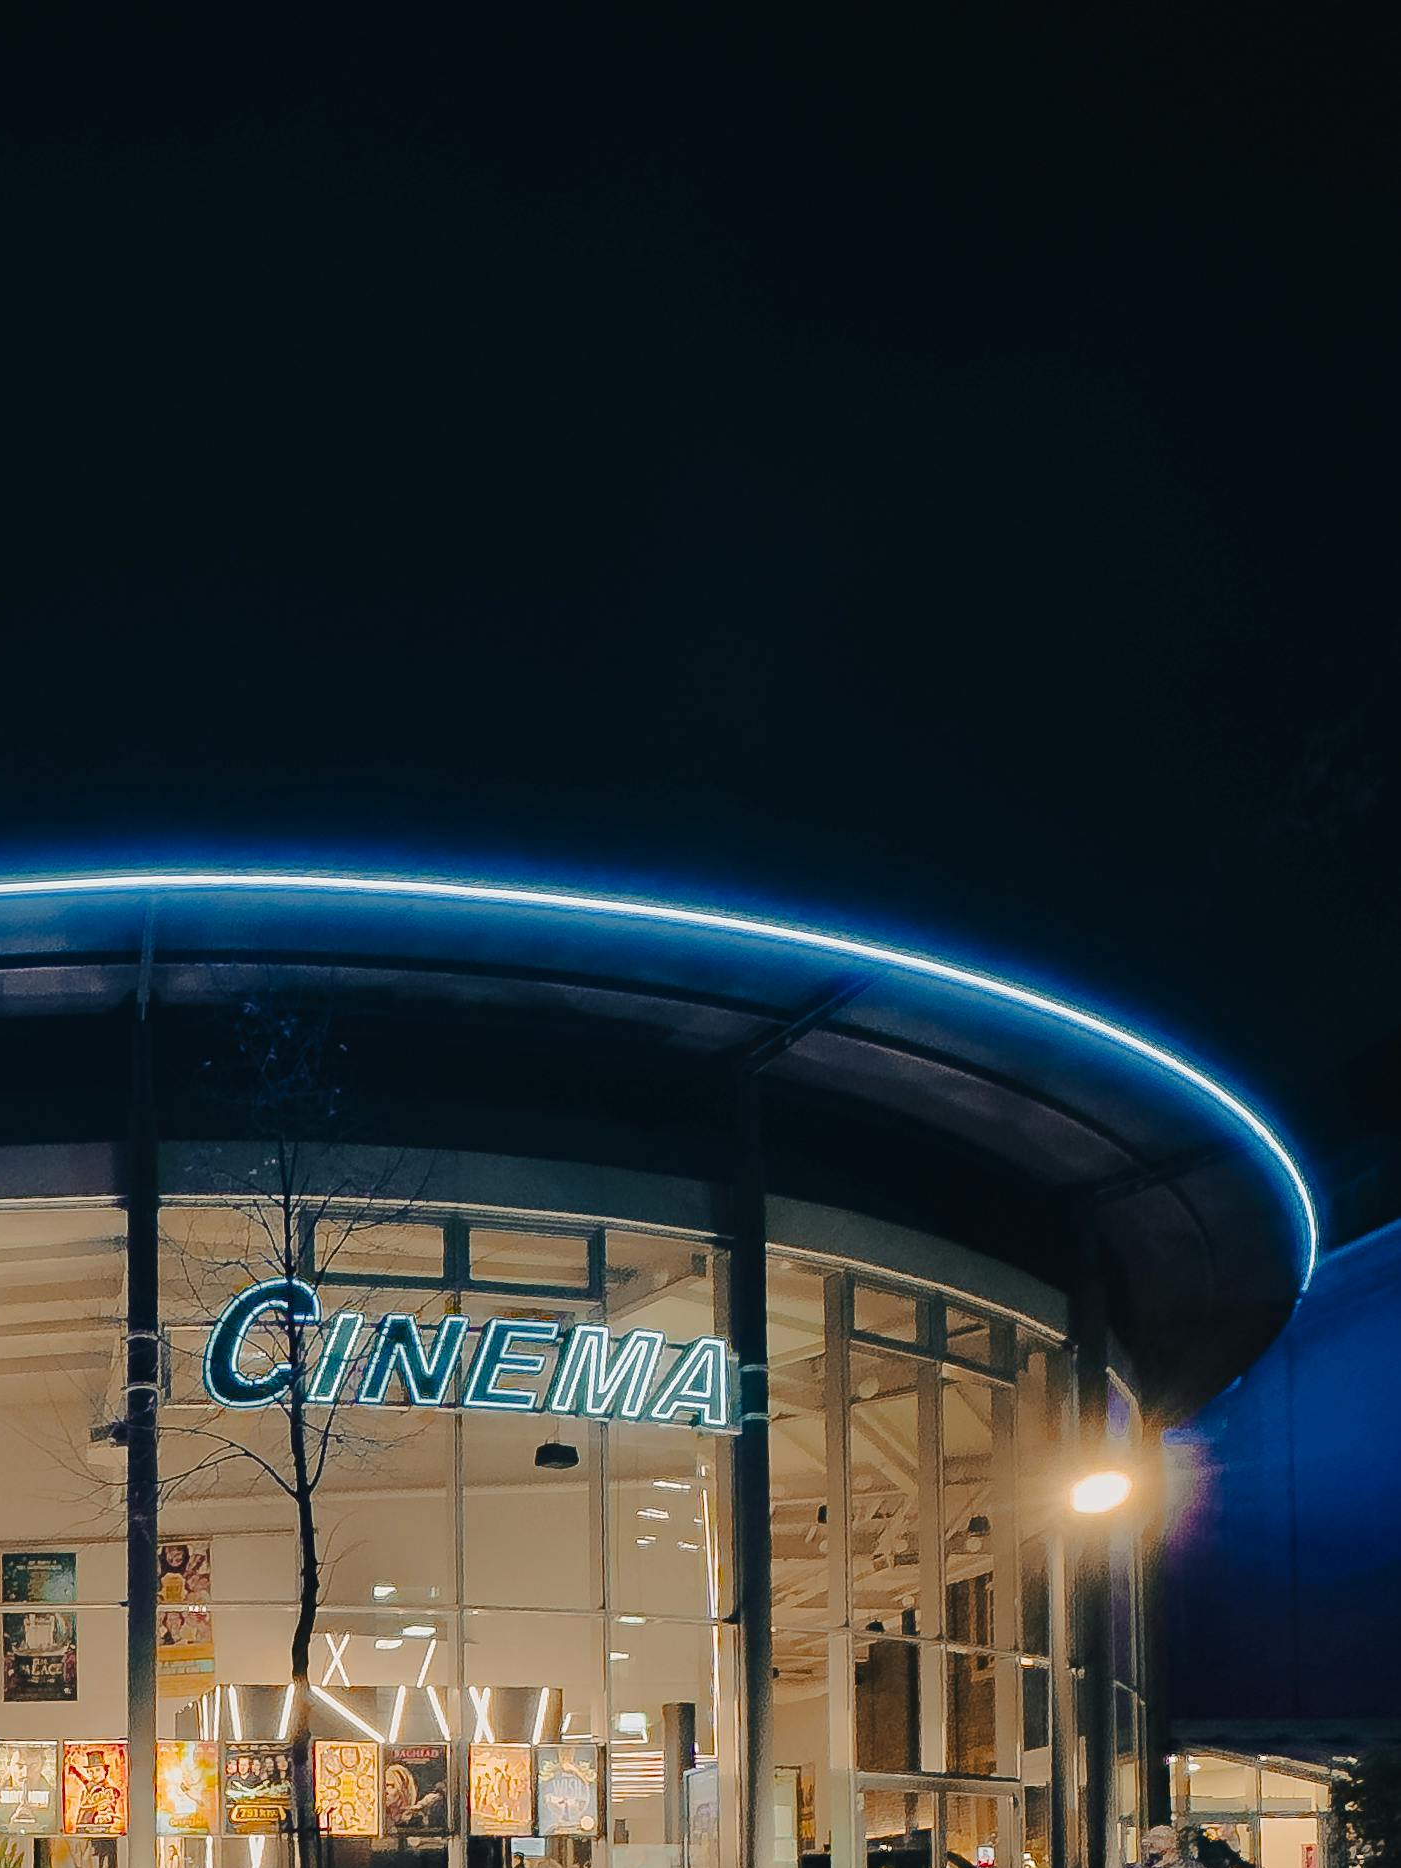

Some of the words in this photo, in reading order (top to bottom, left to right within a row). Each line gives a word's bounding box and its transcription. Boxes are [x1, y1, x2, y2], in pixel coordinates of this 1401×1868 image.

[202, 1276, 735, 1428] CINEMA
[393, 1748, 439, 1759] BAGHEAD
[552, 1780, 583, 1798] WISH
